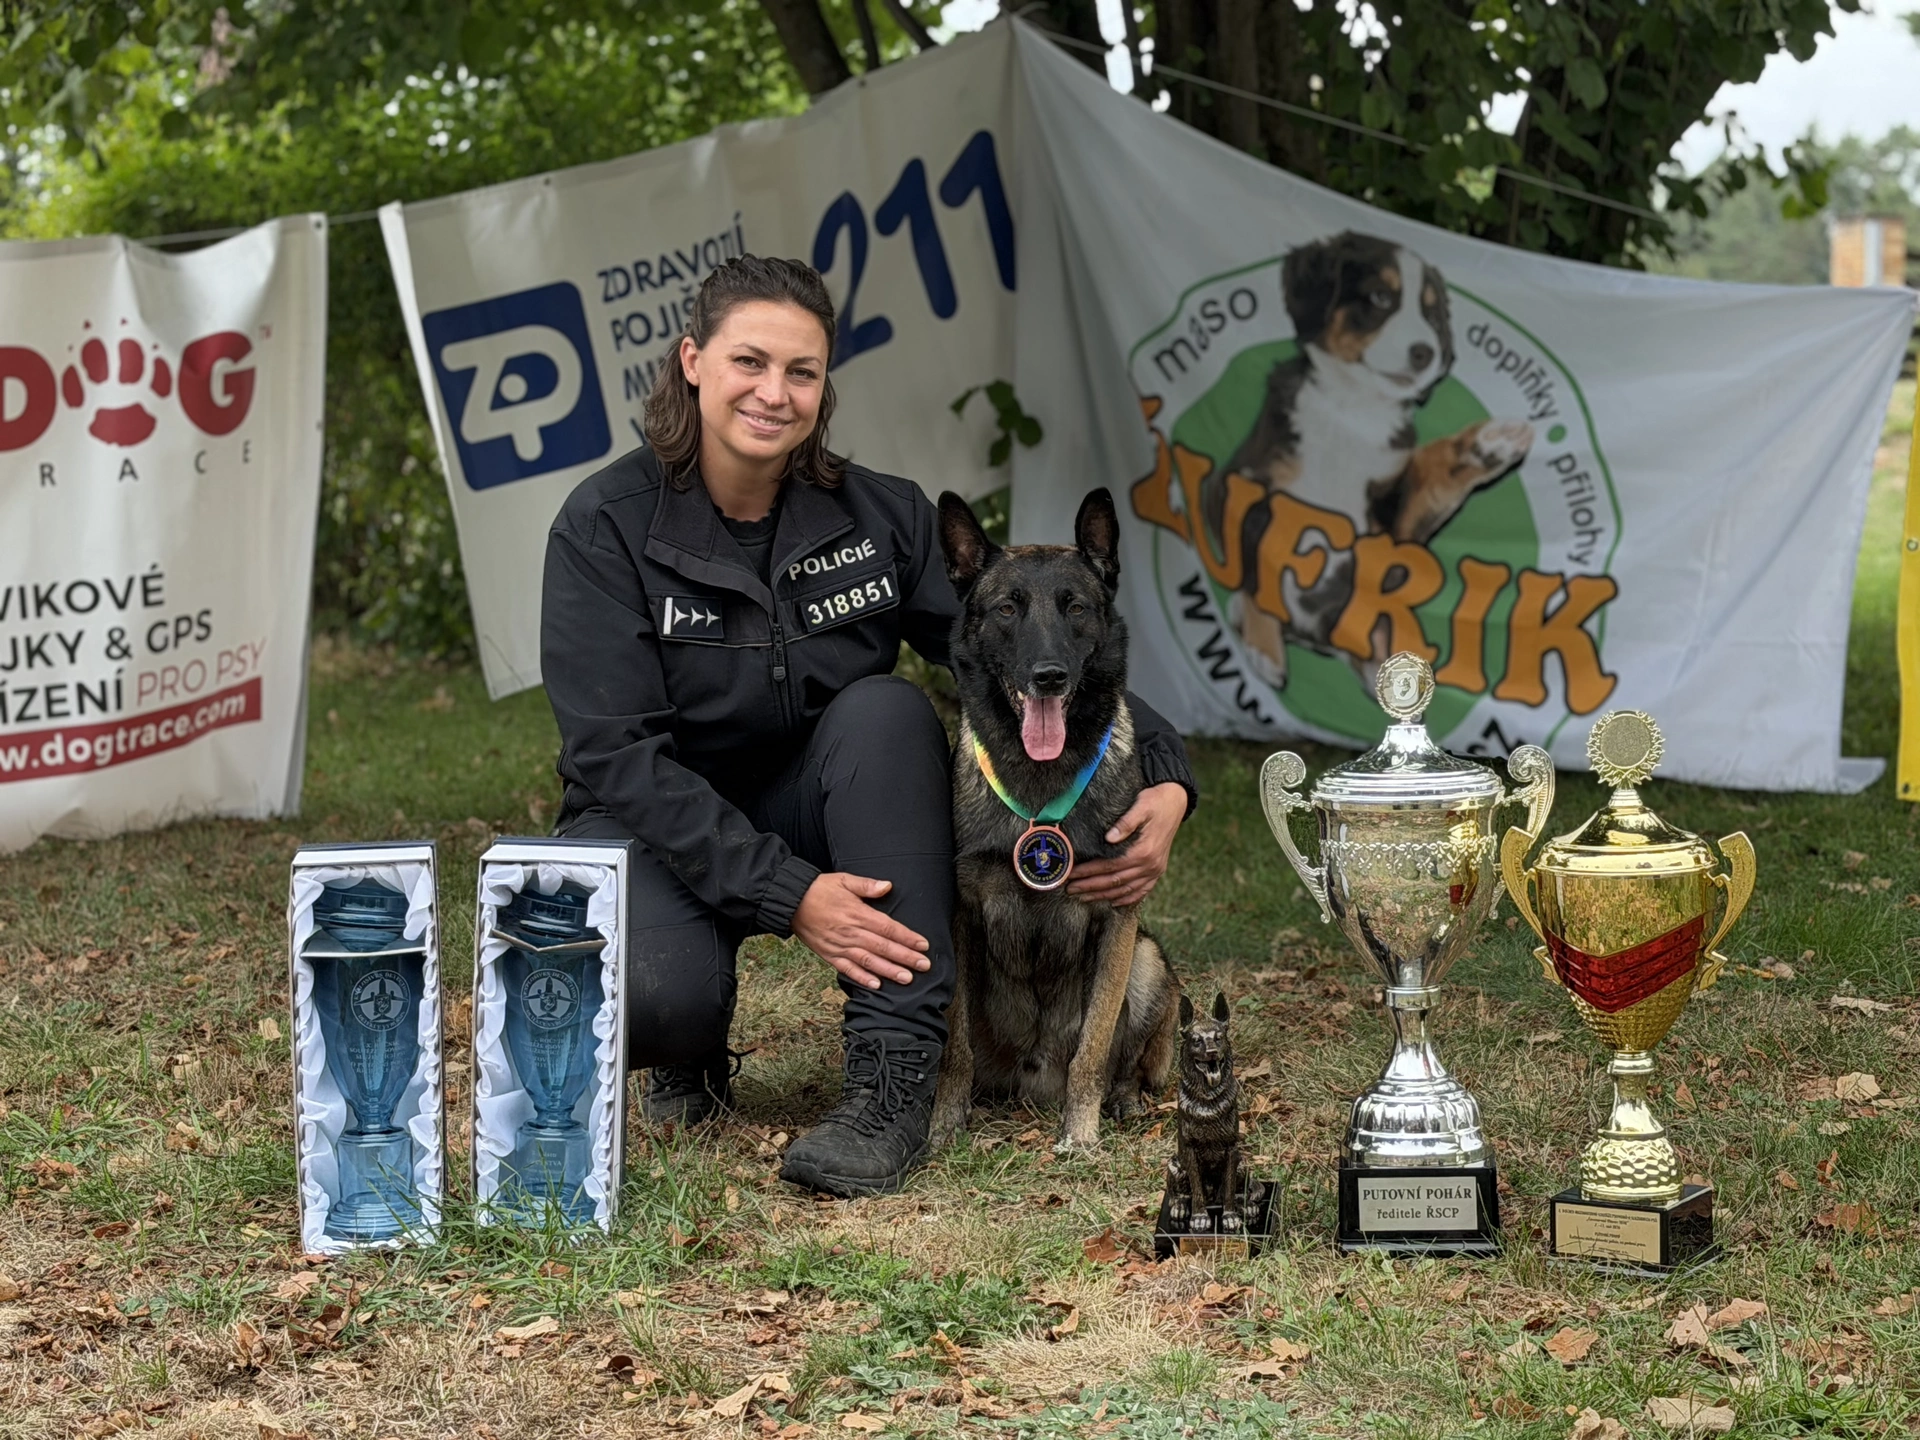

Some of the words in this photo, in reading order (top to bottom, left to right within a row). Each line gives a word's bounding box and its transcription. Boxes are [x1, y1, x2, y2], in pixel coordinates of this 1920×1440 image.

[813, 129, 1017, 372] 211
[1466, 322, 1560, 422] doplňky
[1545, 452, 1604, 566] přílohy
[788, 538, 876, 581] POLICIE
[808, 576, 893, 625] 318851
[104, 626, 132, 661] &
[146, 609, 212, 653] GPS
[137, 659, 208, 707] PRO
[216, 638, 267, 686] PSY
[1363, 1186, 1421, 1200] PUTOVNÍ
[1426, 1185, 1472, 1199] POHÁR
[1377, 1208, 1421, 1219] ředitele
[1426, 1205, 1459, 1218] ŘSCP
